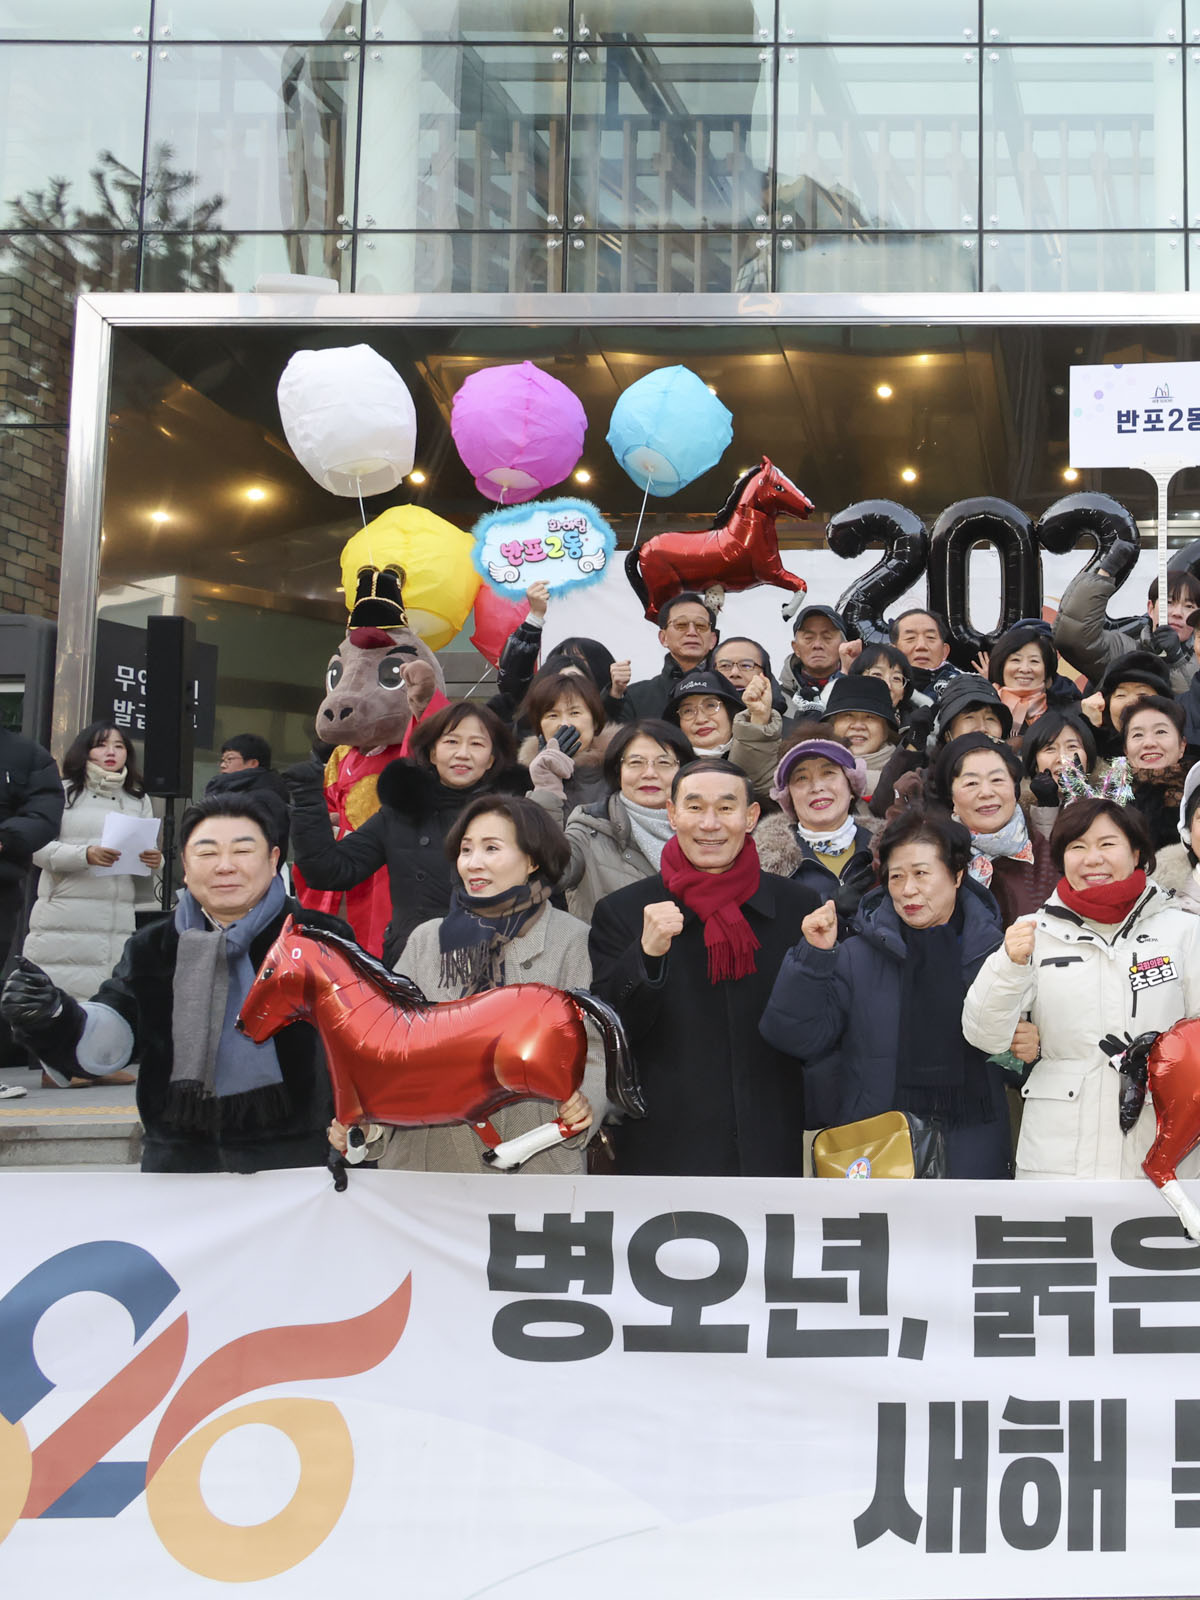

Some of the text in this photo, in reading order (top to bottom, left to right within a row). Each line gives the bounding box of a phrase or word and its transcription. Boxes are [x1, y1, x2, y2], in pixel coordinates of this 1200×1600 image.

[500, 531, 584, 567] 반포2동
[1129, 961, 1179, 991] 조은희
[487, 1210, 928, 1362] 병오년,
[853, 1398, 1127, 1553] 새해
